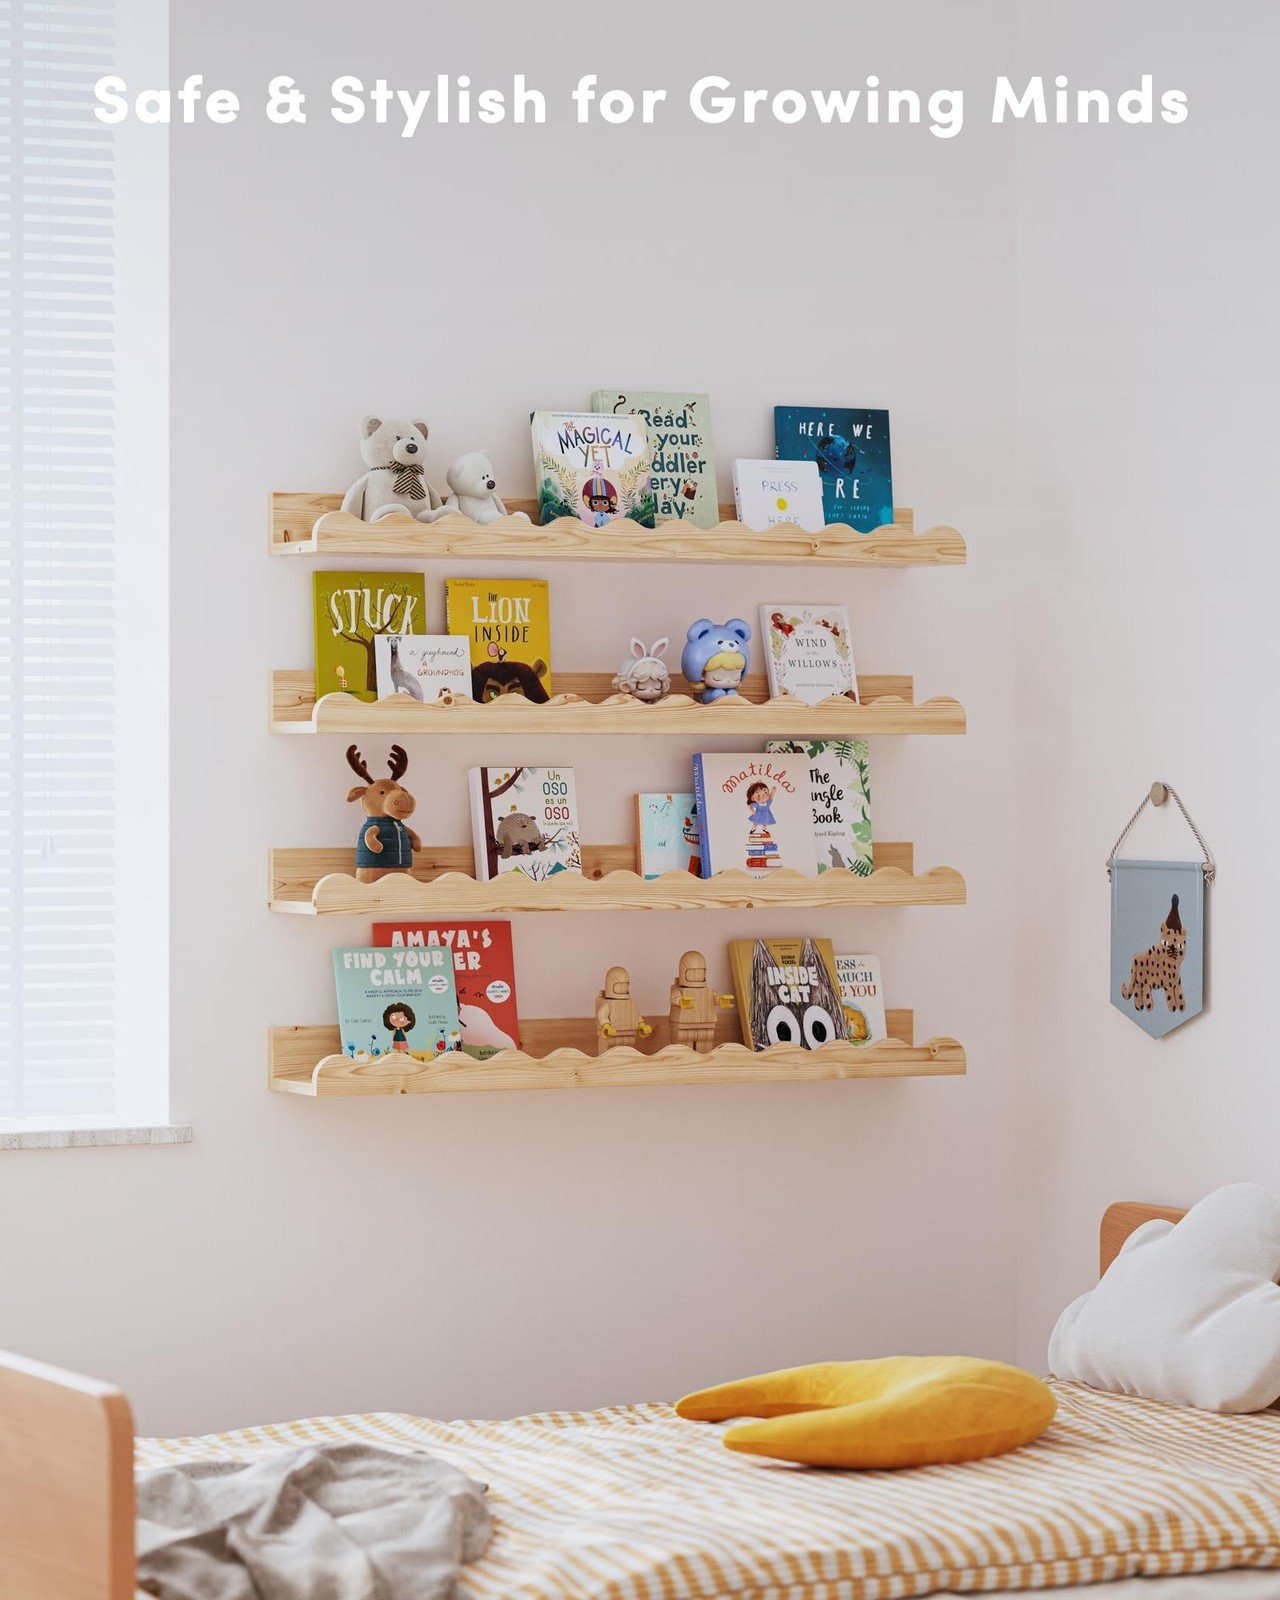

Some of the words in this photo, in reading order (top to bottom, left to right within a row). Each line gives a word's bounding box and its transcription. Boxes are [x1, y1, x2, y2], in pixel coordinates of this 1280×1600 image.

[563, 421, 576, 432] THE
[641, 409, 688, 428] Read
[799, 422, 835, 437] HERE
[852, 424, 873, 439] WE
[557, 426, 633, 454] MAGICAL
[656, 432, 698, 451] your
[578, 445, 612, 468] YET
[651, 451, 706, 474] ddler
[650, 476, 682, 497] ery
[762, 480, 798, 493] PRESS
[836, 478, 860, 499] RE
[488, 592, 498, 602] THE
[330, 588, 418, 637] STUCK
[471, 596, 531, 624] LION
[475, 625, 530, 643] INSIDE
[795, 638, 827, 648] WIND
[417, 668, 465, 677] GROUNDHOG
[788, 659, 838, 668] WILLOWS
[547, 770, 560, 781] Un
[722, 762, 796, 794] Matilda
[809, 768, 831, 785] The
[542, 782, 568, 795] OSO
[811, 784, 844, 809] ngle
[544, 806, 570, 820] OSO
[391, 928, 492, 948] AMAYA'S
[343, 952, 386, 969] FIND
[392, 950, 445, 967] YOUR
[837, 959, 857, 970] ESS
[370, 968, 422, 986] CALM
[766, 966, 818, 986] INSIDE
[837, 972, 873, 983] MUCH
[778, 985, 810, 1003] CAT
[850, 985, 877, 997] YOU
